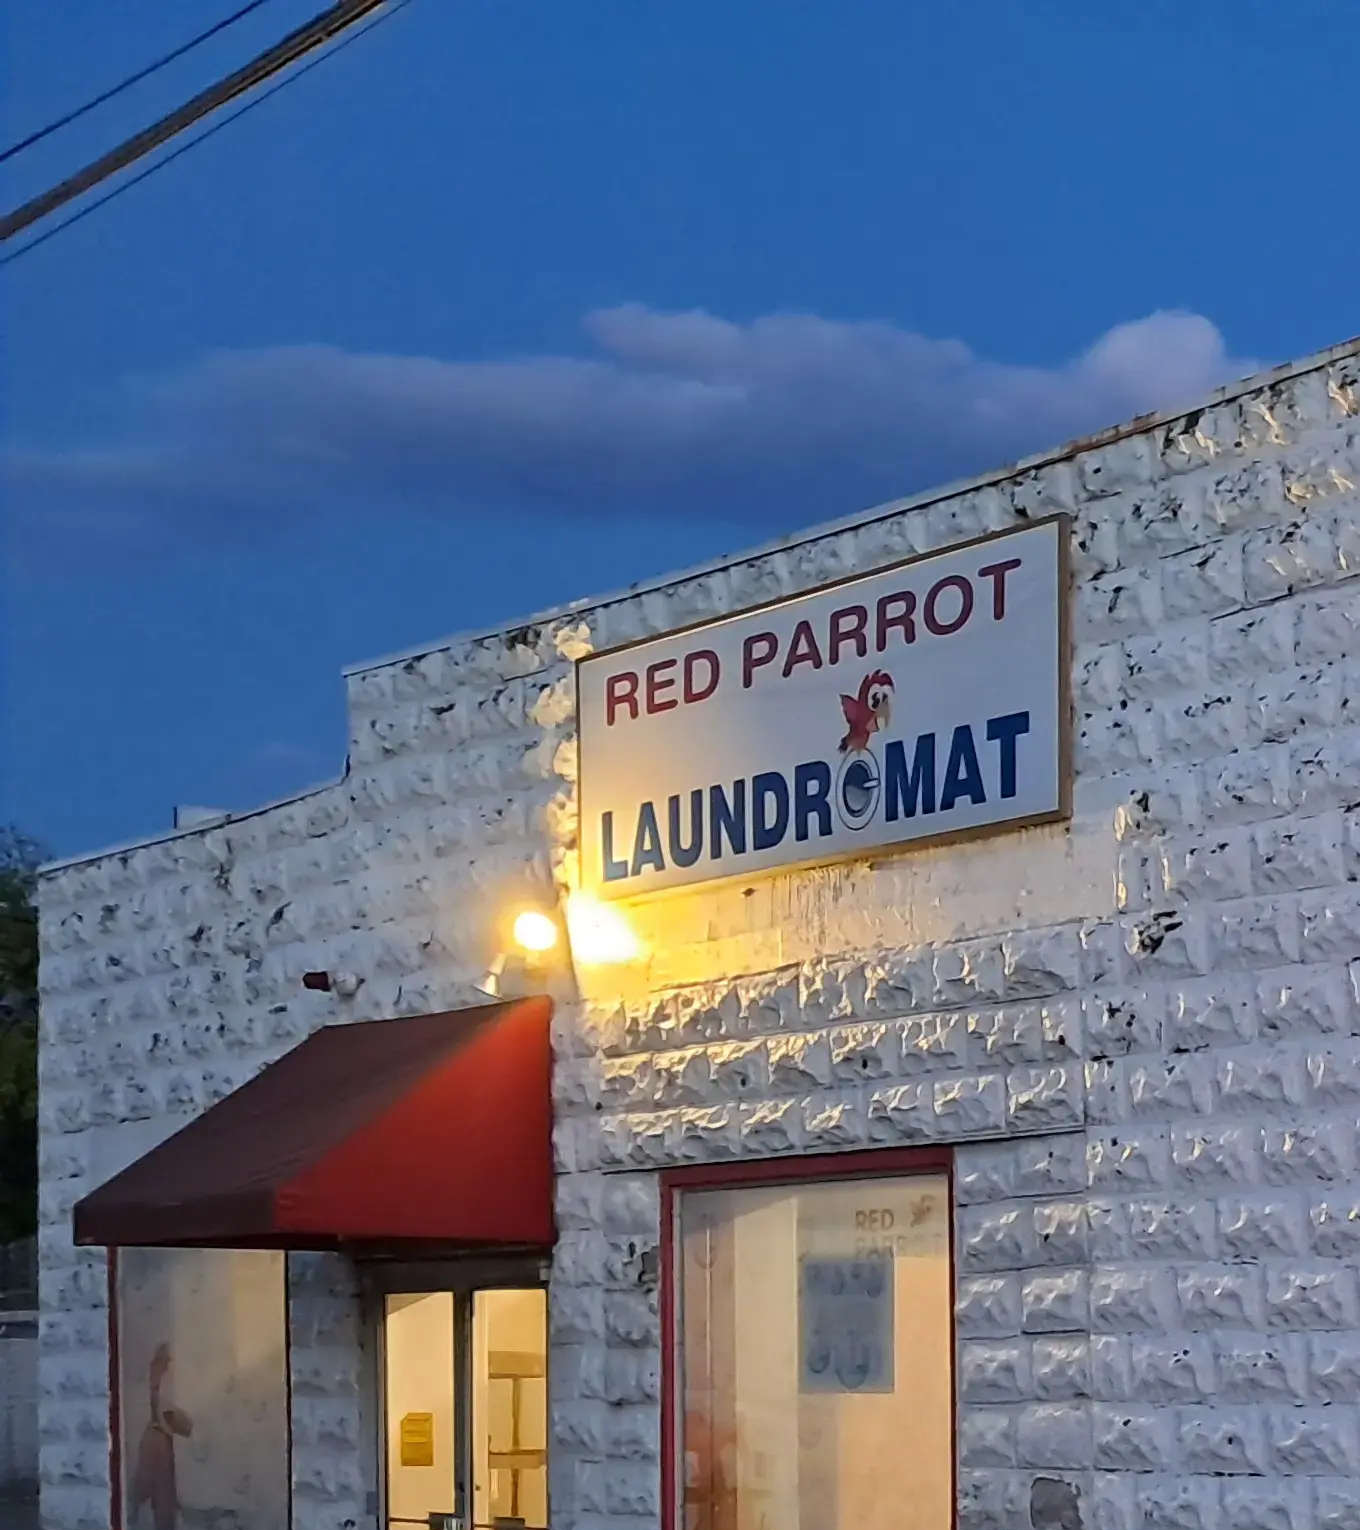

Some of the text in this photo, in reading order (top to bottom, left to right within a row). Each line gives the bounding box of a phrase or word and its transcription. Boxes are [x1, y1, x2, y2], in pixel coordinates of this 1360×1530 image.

[605, 557, 1023, 727] RED PARROT
[601, 710, 1031, 883] LAUNDROMAT
[854, 1233, 943, 1260] PARRT
[855, 1208, 894, 1232] RED
